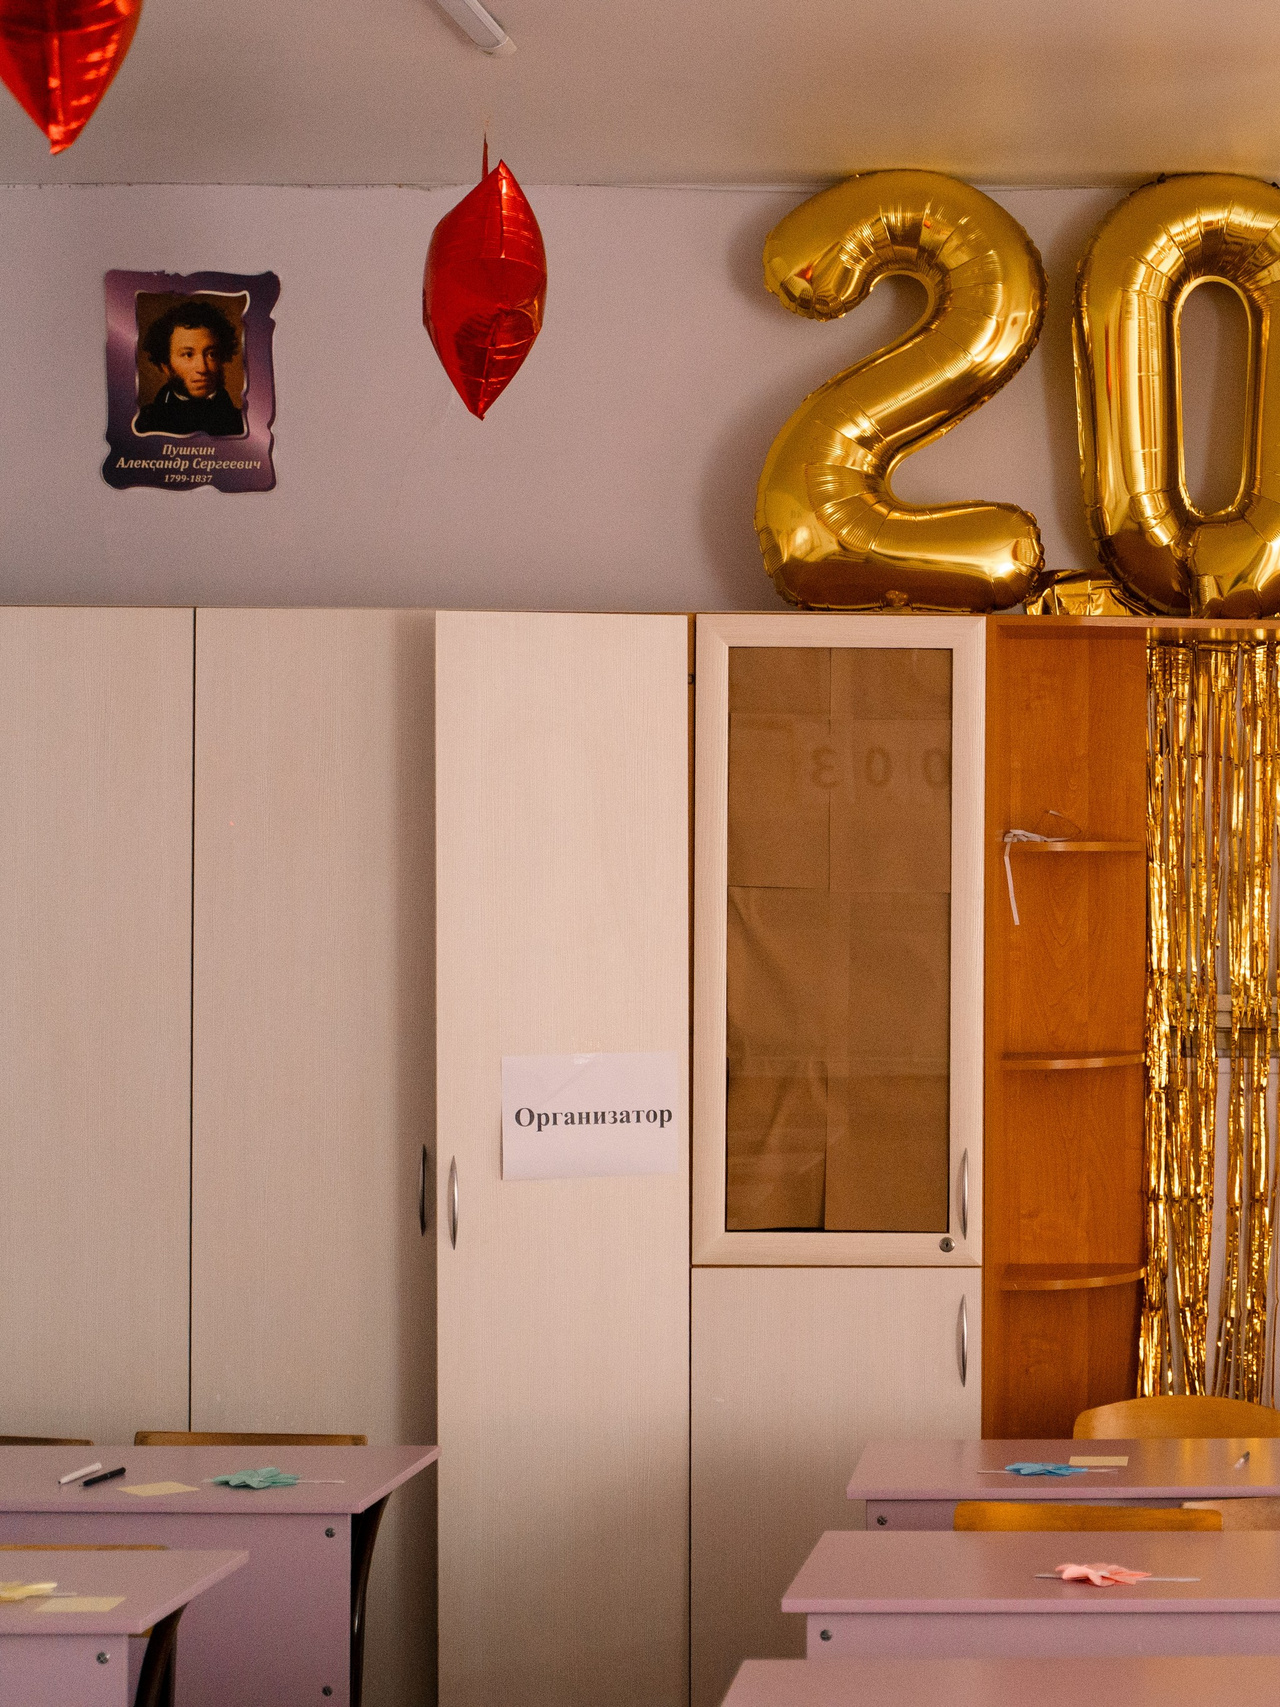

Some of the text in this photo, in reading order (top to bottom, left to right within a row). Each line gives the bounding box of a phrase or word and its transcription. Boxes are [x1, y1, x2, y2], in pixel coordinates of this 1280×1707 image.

[162, 444, 215, 457] Пушкин
[116, 457, 261, 471] Александр Сергеевич
[164, 474, 213, 483] 1799-1837
[514, 1106, 673, 1133] Организатор
